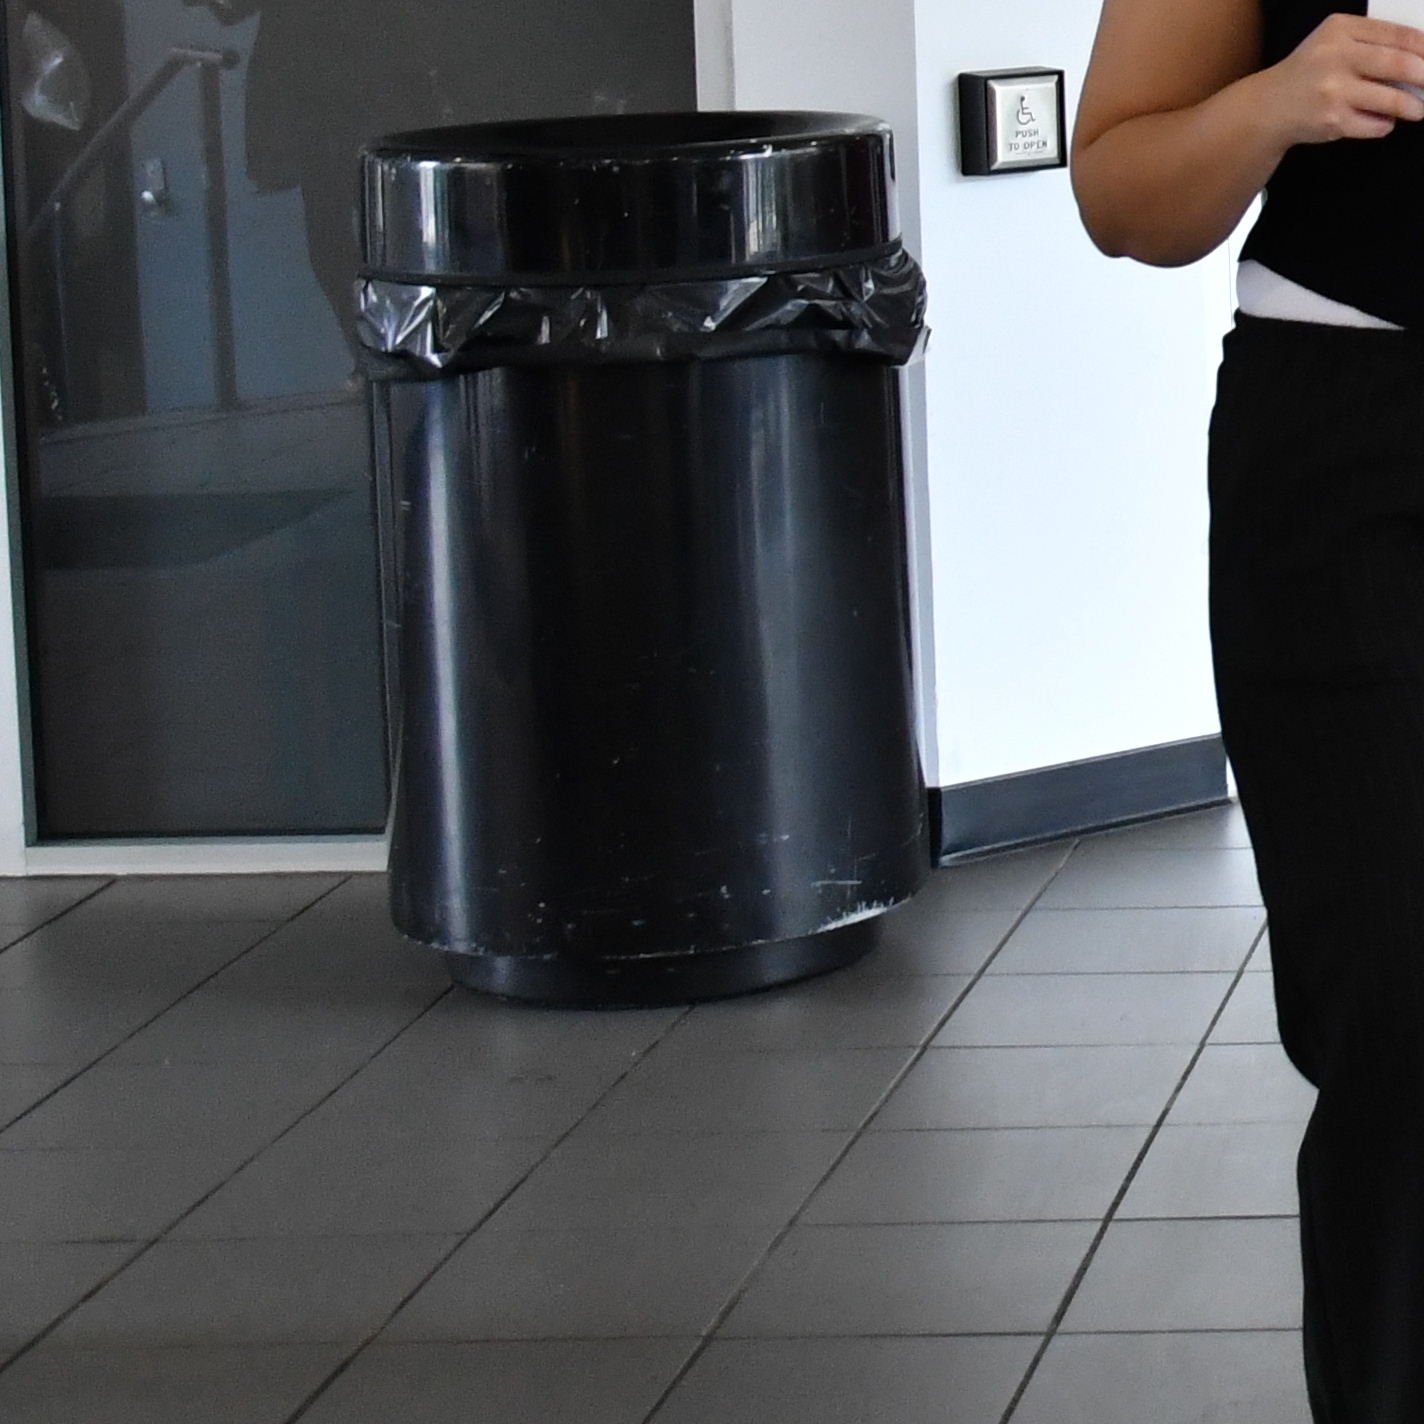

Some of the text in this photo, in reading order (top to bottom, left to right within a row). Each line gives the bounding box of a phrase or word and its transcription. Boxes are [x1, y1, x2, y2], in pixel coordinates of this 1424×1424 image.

[1015, 129, 1040, 138] PUSH
[1008, 139, 1048, 151] TO OPEN
